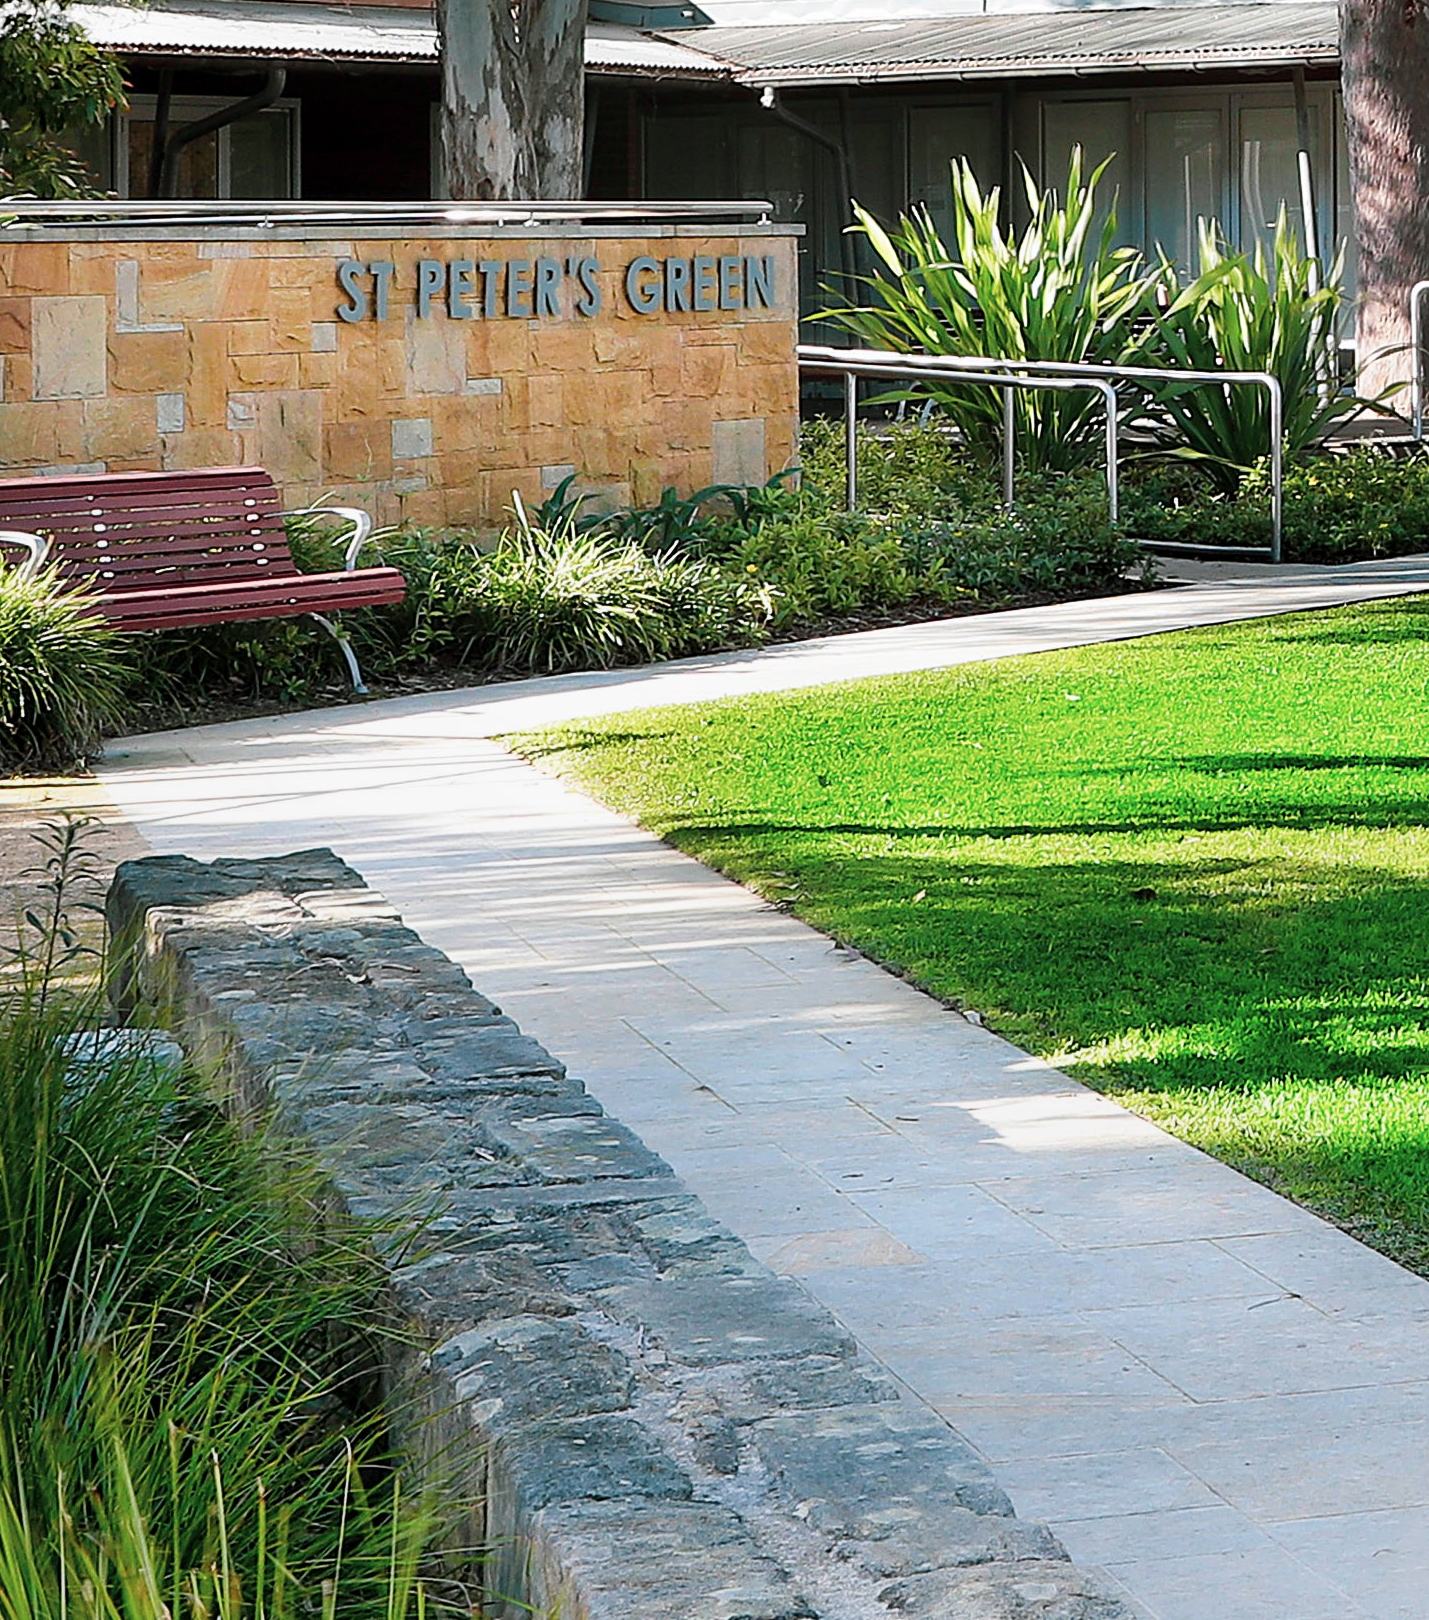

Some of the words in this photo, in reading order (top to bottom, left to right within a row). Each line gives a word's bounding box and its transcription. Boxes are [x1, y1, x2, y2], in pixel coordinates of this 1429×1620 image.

[336, 259, 396, 323] ST
[416, 256, 603, 321] PETER'S
[625, 254, 776, 316] GREEN
